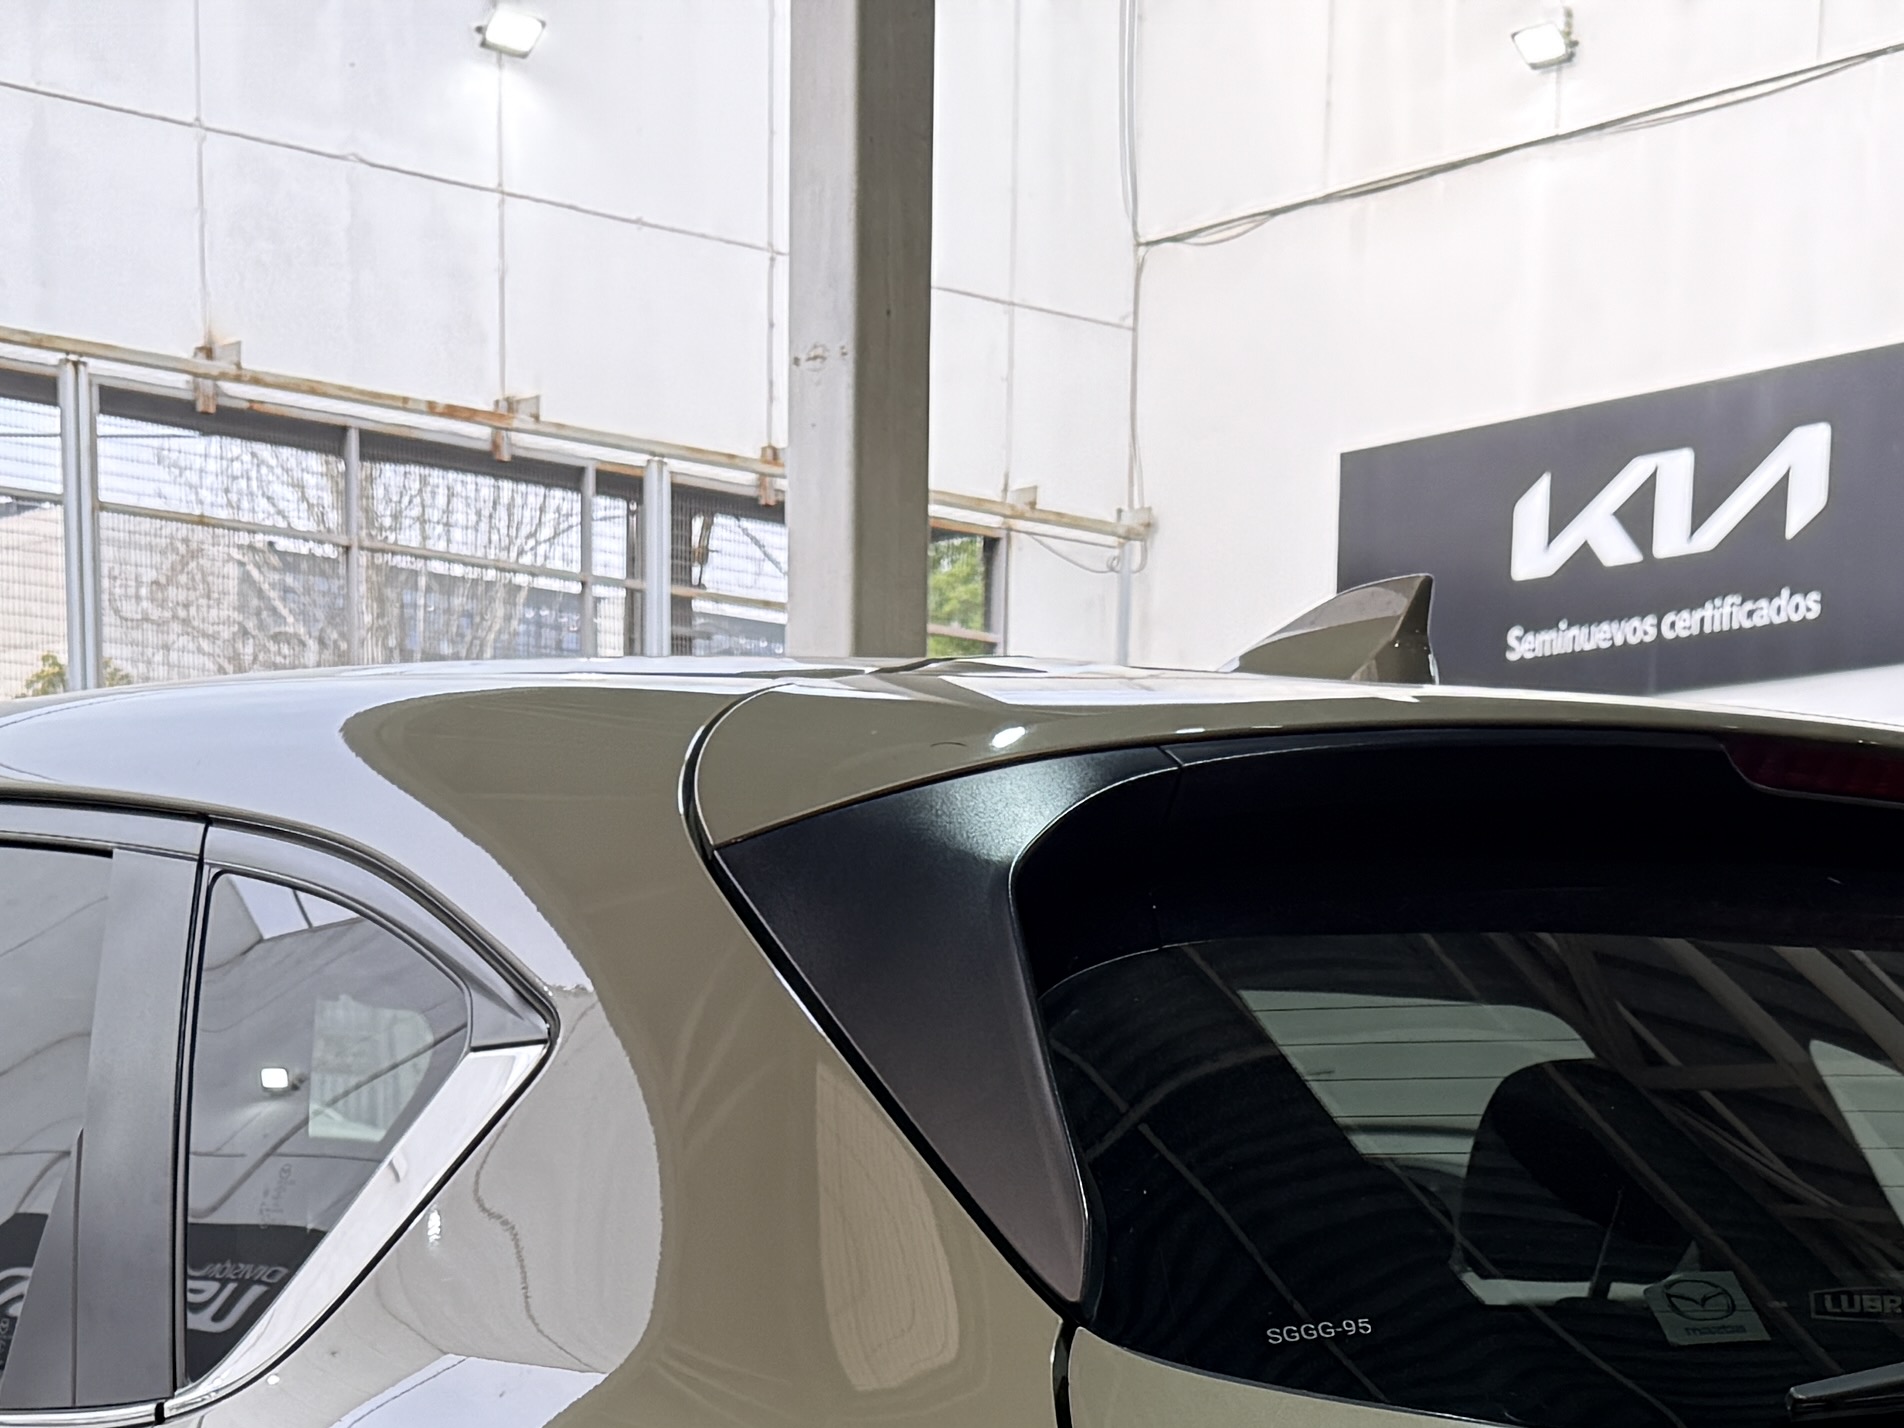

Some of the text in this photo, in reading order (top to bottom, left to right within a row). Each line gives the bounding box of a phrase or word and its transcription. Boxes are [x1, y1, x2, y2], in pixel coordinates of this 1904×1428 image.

[1510, 421, 1832, 582] KIA
[1505, 585, 1822, 662] Seminuevos certificados
[1266, 1318, 1372, 1345] SGGG-95
